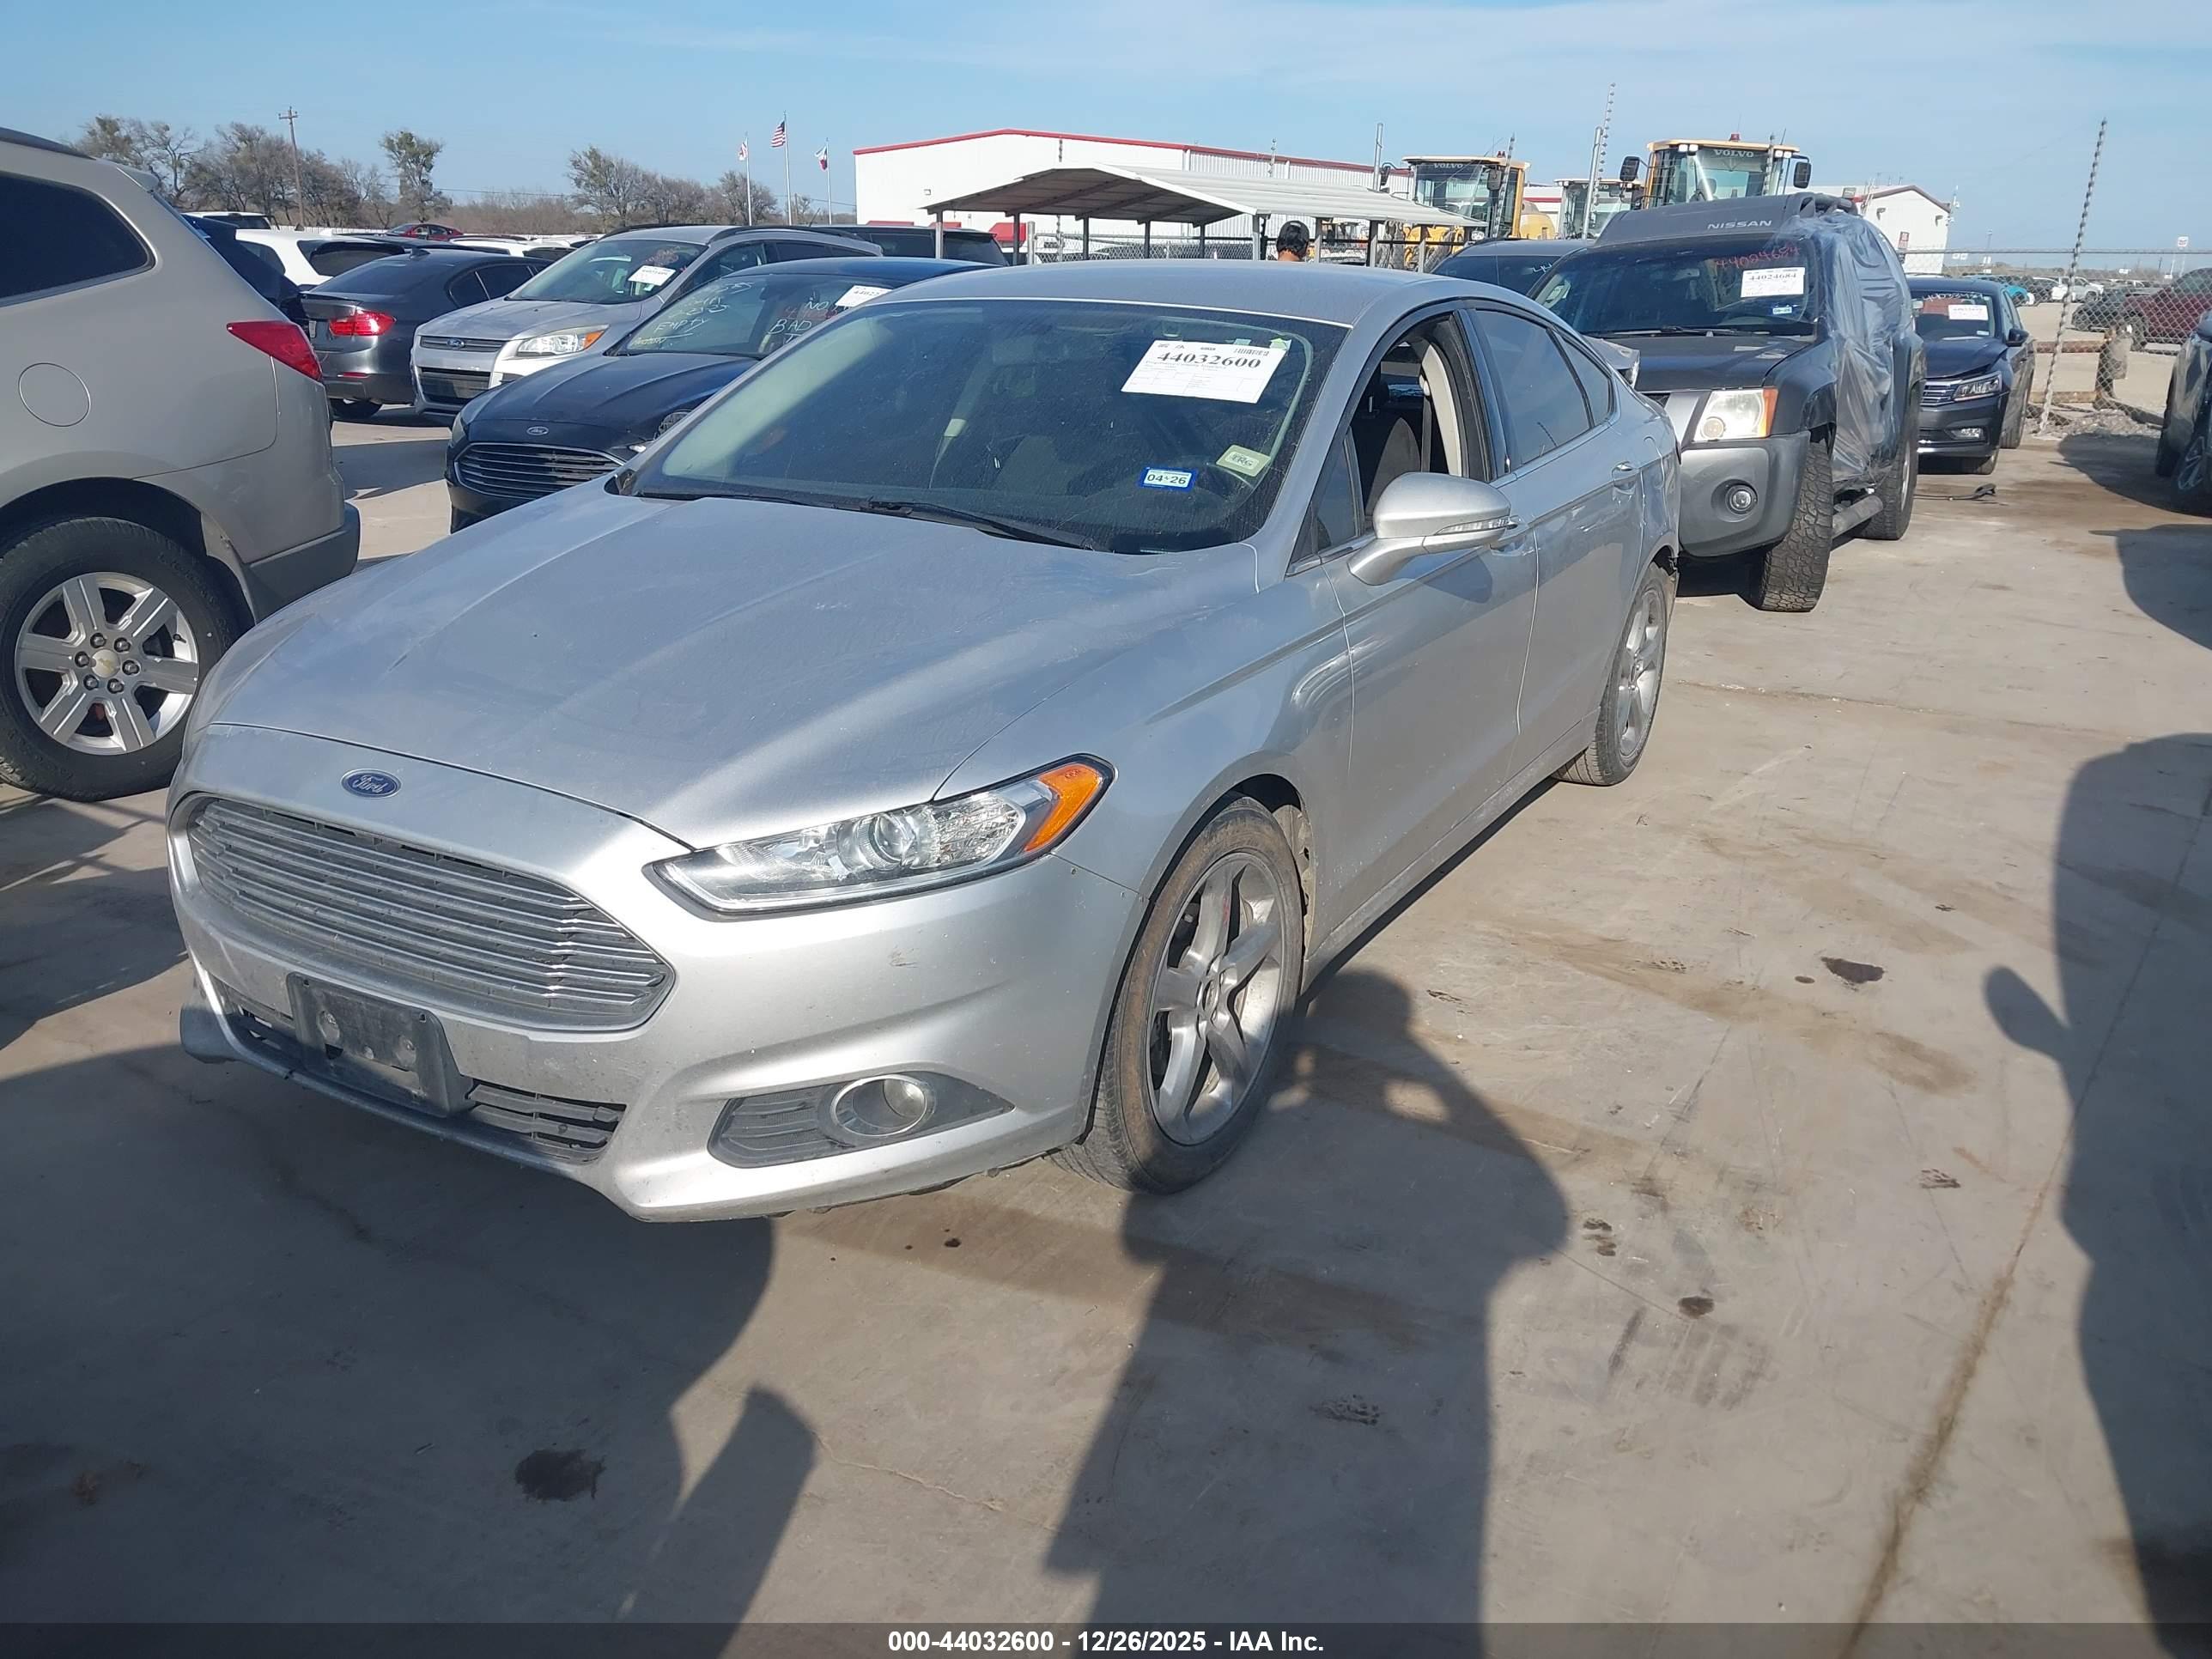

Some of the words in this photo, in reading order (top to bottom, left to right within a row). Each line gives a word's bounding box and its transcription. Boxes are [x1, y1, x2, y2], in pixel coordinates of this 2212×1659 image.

[1713, 149, 1754, 158] VOLVO
[1707, 220, 1773, 230] NISSAN
[768, 319, 812, 335] BAD
[1157, 351, 1261, 369] 44032600
[351, 775, 388, 793] Ford
